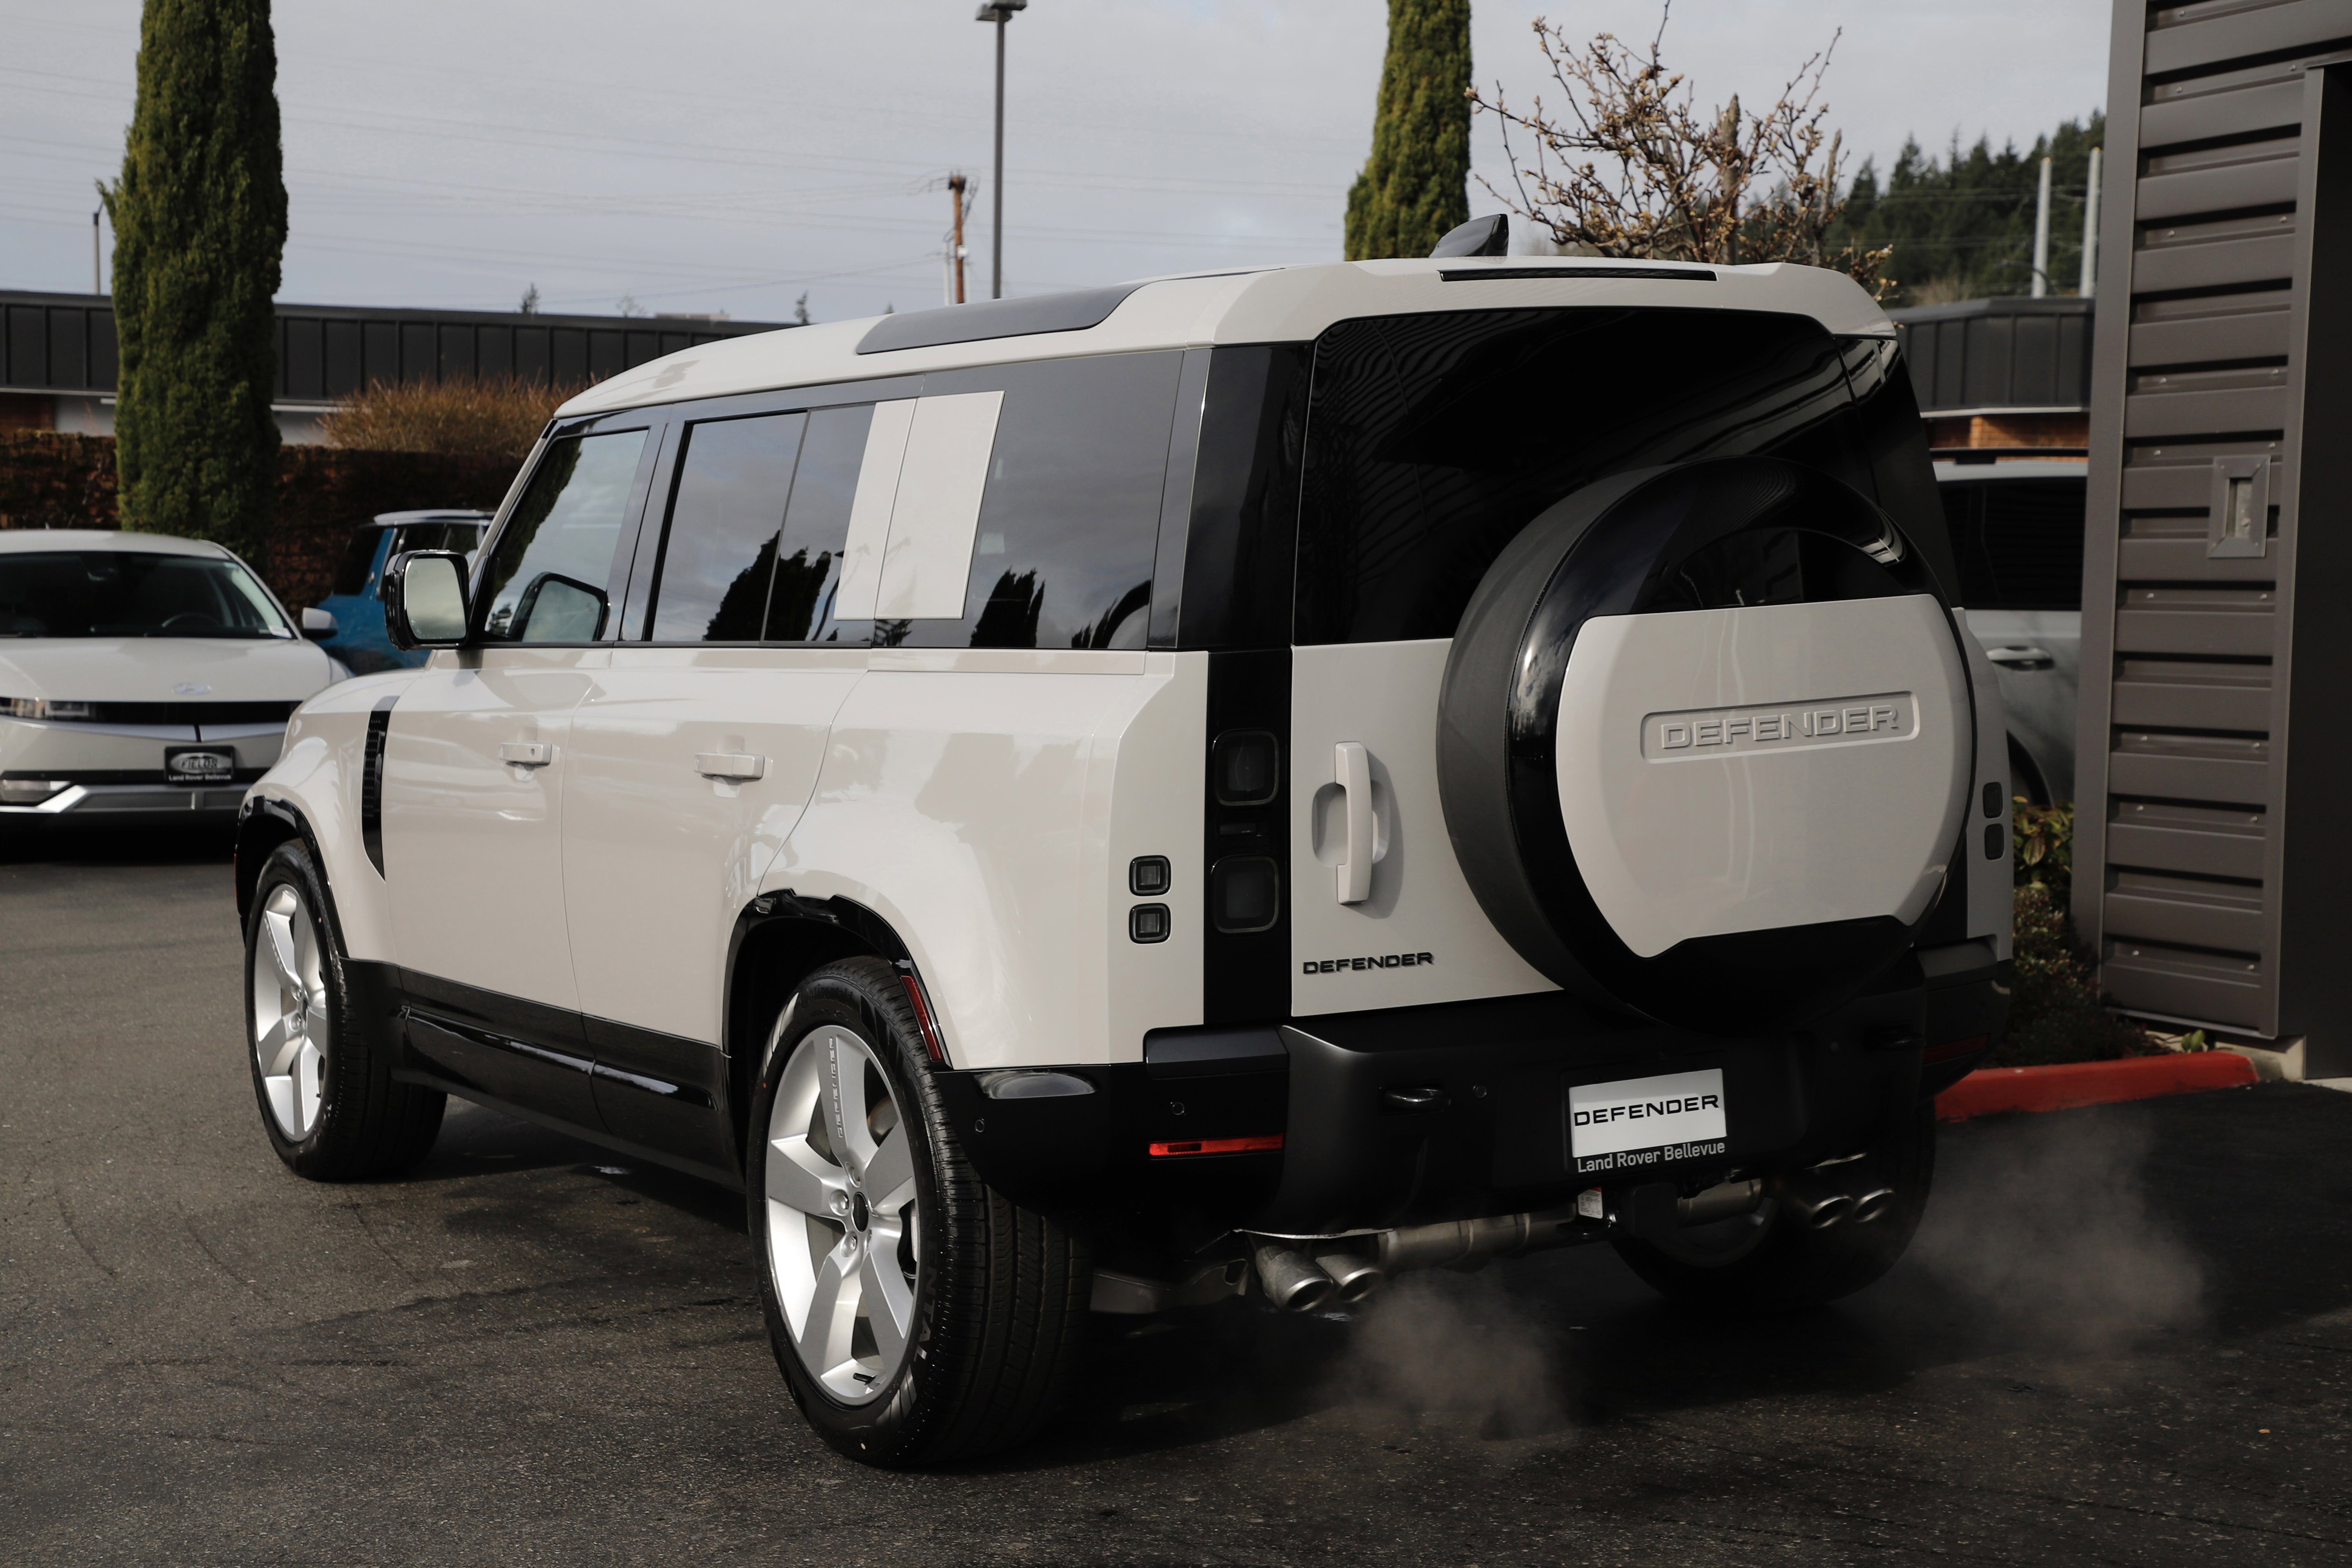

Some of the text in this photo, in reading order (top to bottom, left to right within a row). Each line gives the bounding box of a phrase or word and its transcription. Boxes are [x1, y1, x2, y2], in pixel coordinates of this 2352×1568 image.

[1661, 705, 1898, 749] DEFENDER
[1303, 952, 1432, 974] DEFENDER
[1574, 1094, 1719, 1126] DEFENDER
[1577, 1142, 1725, 1173] Land Rover Bellevue
